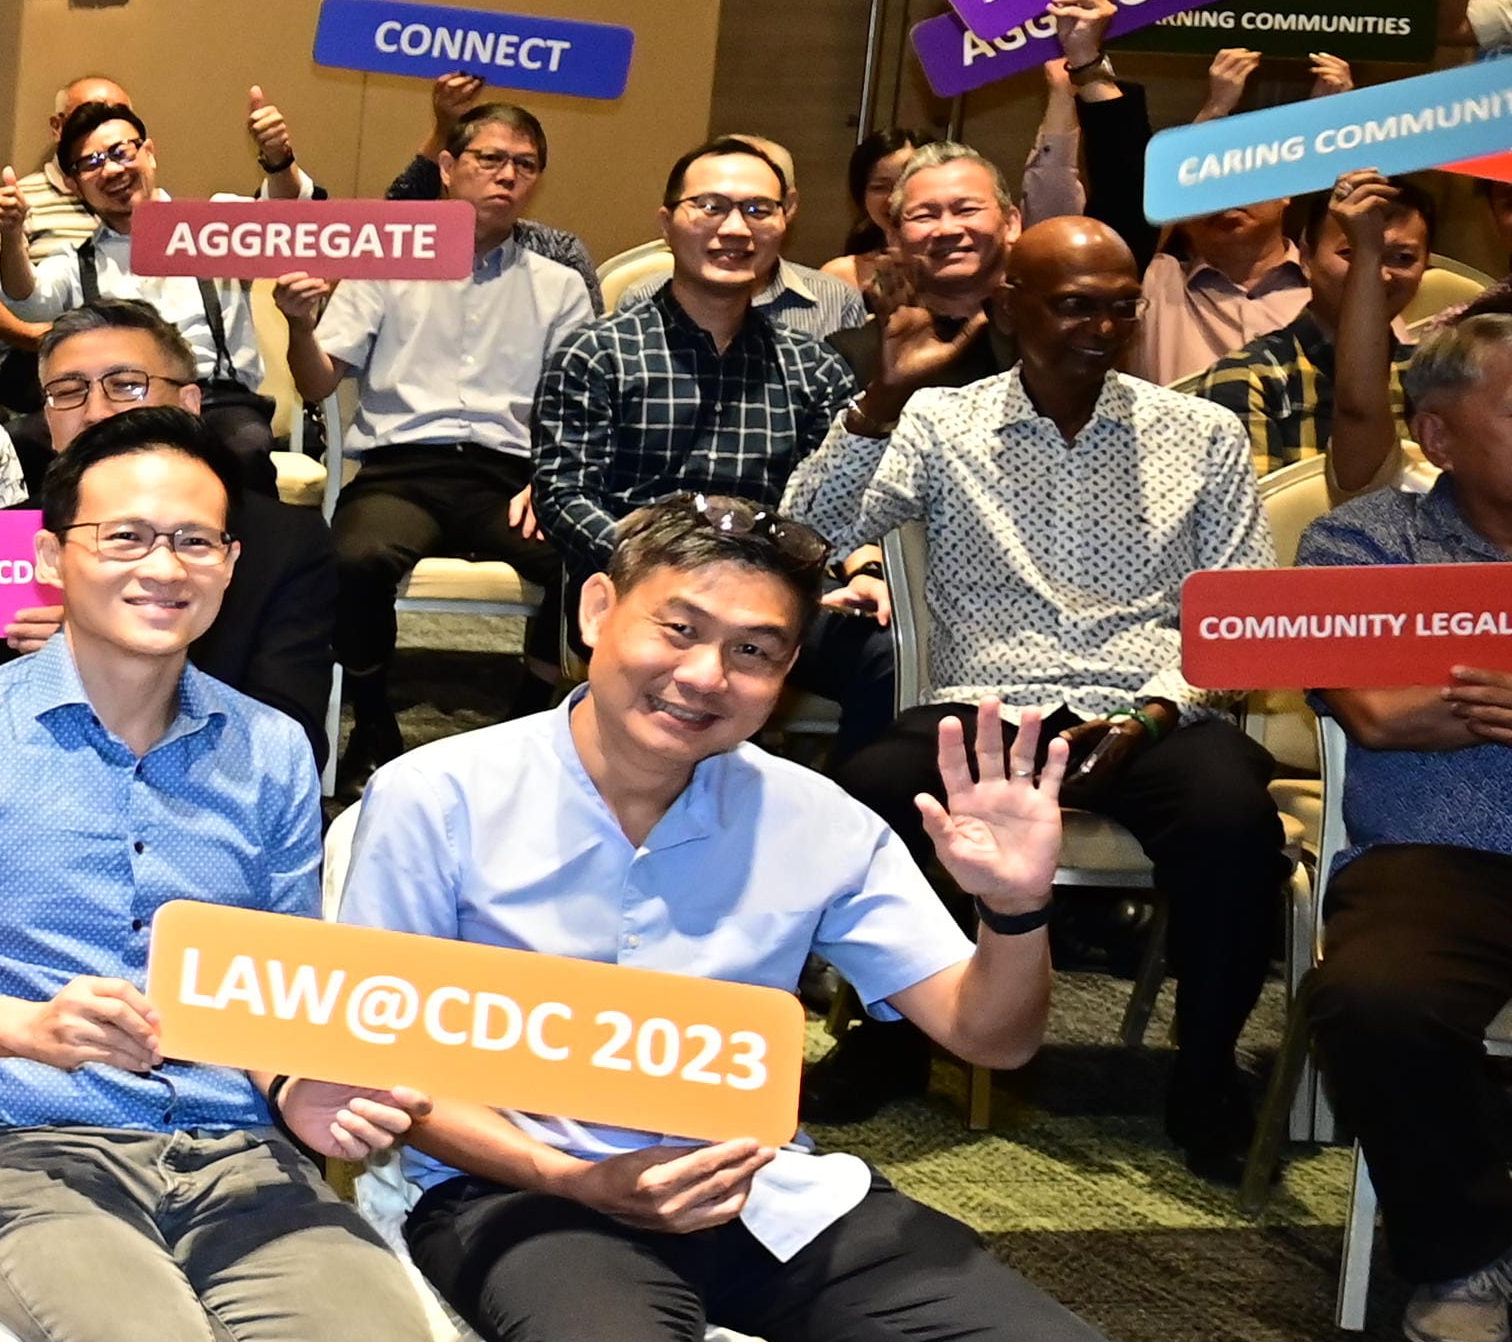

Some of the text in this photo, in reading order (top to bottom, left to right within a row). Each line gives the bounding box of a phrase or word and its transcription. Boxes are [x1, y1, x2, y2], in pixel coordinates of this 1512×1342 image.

[374, 20, 570, 72] CONNECT
[1241, 13, 1411, 35] COMMUNITIES
[1178, 137, 1306, 186] CARING
[166, 221, 437, 260] AGGREGATE
[1200, 613, 1406, 640] COMMUNITY
[179, 947, 768, 1091] LAW@CDC 2023
